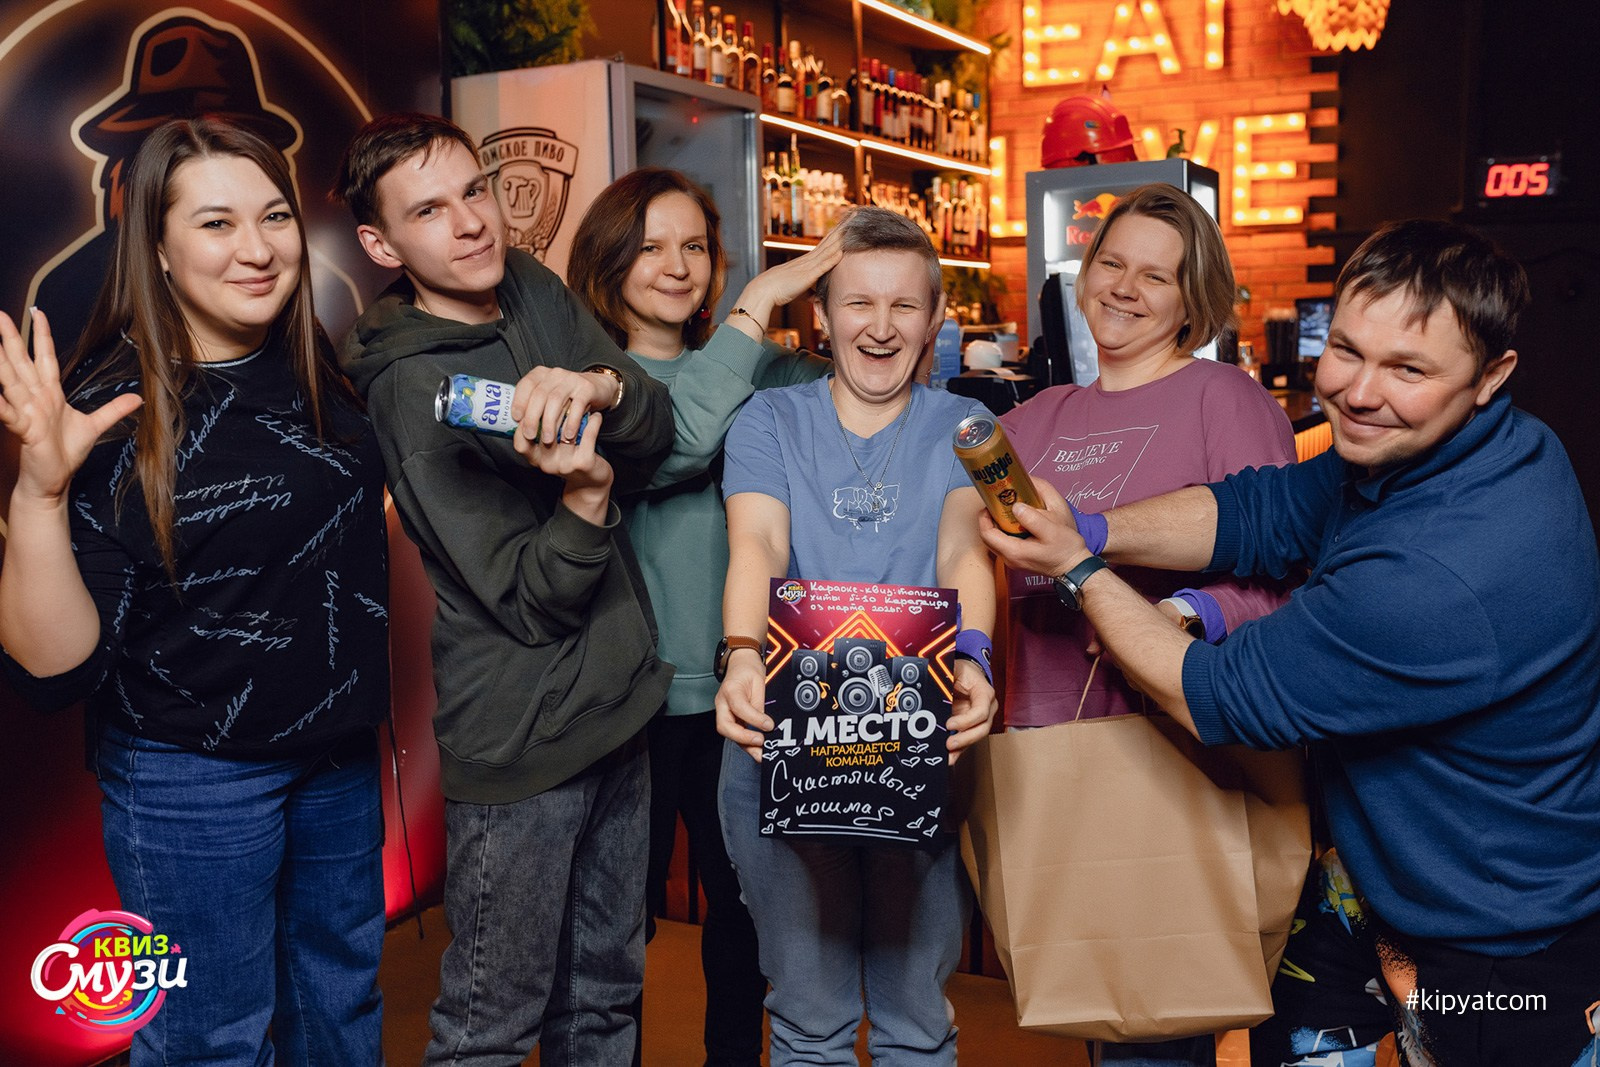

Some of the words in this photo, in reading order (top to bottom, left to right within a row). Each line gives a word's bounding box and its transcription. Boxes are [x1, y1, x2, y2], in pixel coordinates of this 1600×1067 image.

[533, 140, 565, 163] ПИВО
[1484, 162, 1550, 198] 005
[1066, 225, 1094, 246] Re
[481, 383, 502, 426] ava
[1052, 440, 1124, 464] BELIEVE
[1054, 455, 1107, 473] SOMETHING
[1025, 575, 1047, 586] WILL
[827, 603, 866, 613] марта
[777, 718, 797, 748] 1
[804, 709, 938, 746] МЕСТО
[810, 741, 901, 757] НАГРАЖДАЕТСЯ
[825, 754, 884, 768] КОМАНДА
[770, 759, 926, 803] Счастливый
[795, 801, 895, 827] кошмар
